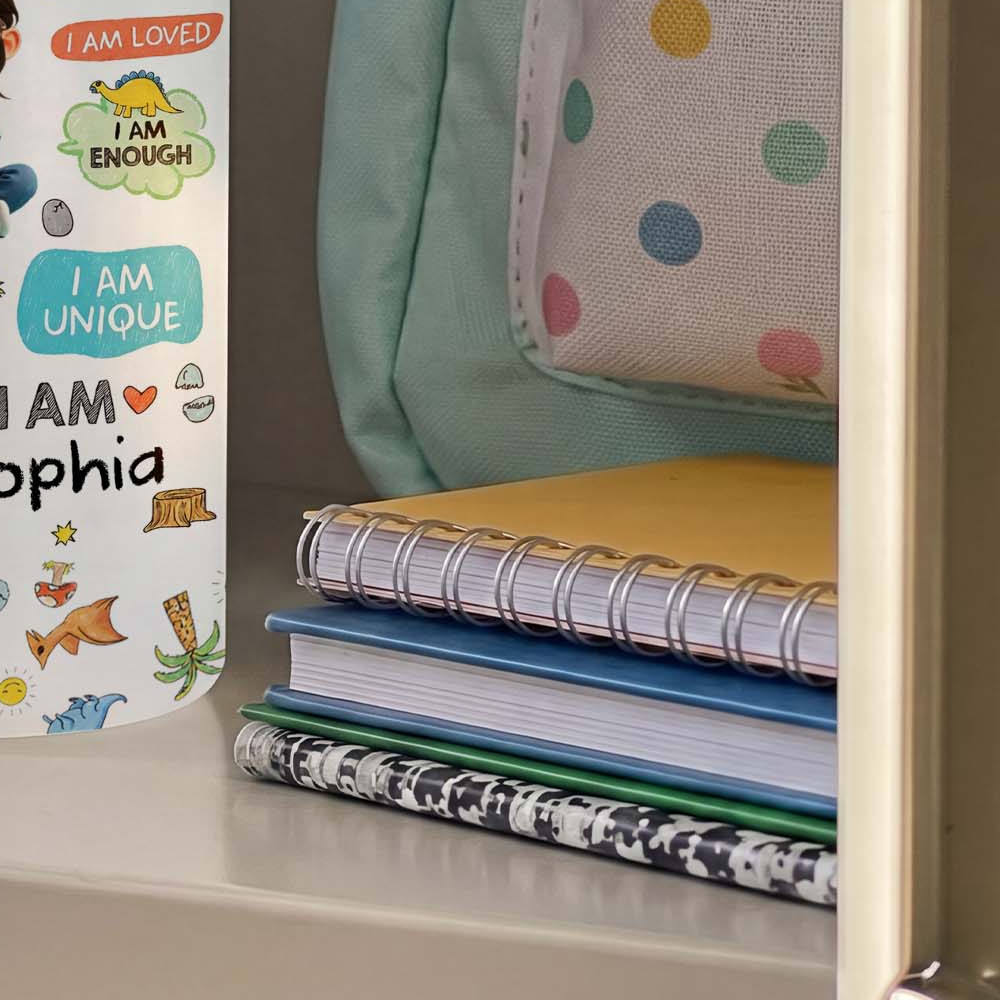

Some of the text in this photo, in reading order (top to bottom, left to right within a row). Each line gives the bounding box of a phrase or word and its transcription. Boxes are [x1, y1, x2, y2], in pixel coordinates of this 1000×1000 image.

[65, 22, 211, 53] I AM LOVED
[113, 120, 166, 141] I AM
[90, 144, 192, 168] ENOUGH
[71, 263, 153, 295] I AM
[44, 301, 180, 334] UNIQUE
[25, 380, 115, 428] AM
